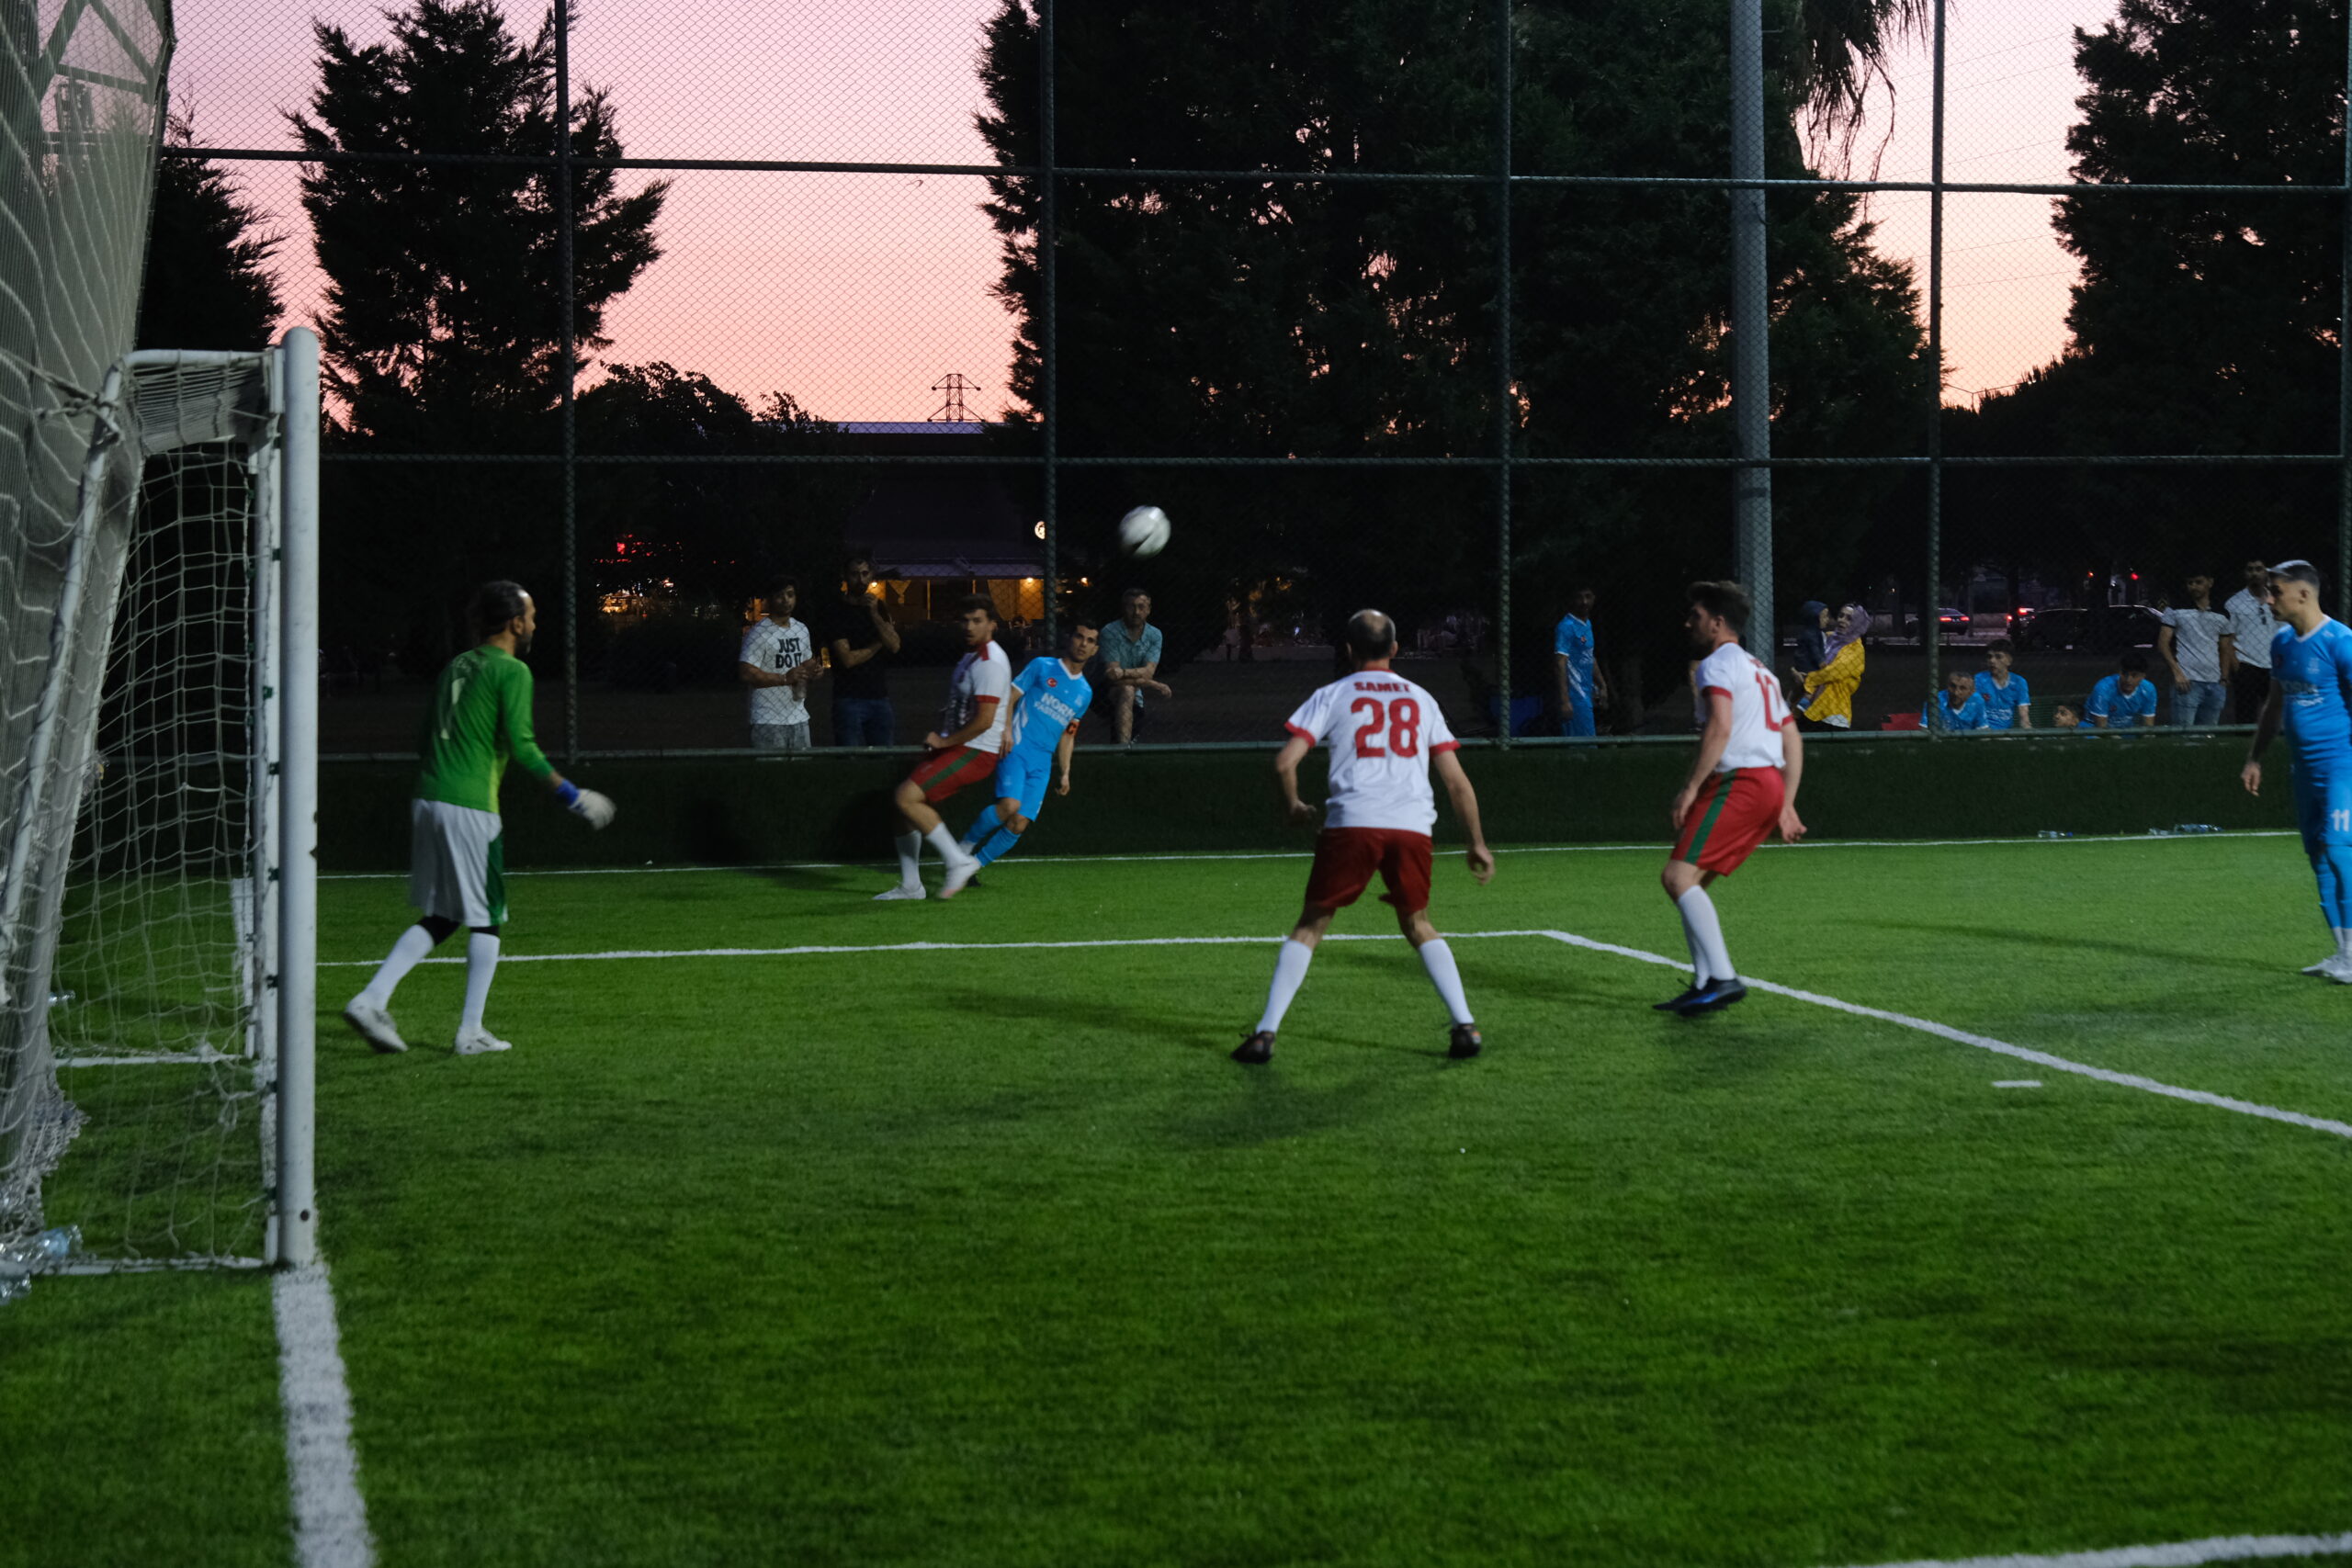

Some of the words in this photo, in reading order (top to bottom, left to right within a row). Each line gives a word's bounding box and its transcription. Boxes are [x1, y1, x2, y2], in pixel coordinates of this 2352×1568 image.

[778, 637, 800, 653] JUST
[775, 653, 792, 669] DO
[794, 652, 802, 667] IT
[1354, 682, 1410, 693] SAMET
[1351, 697, 1420, 758] 28
[2330, 808, 2350, 832] 11
